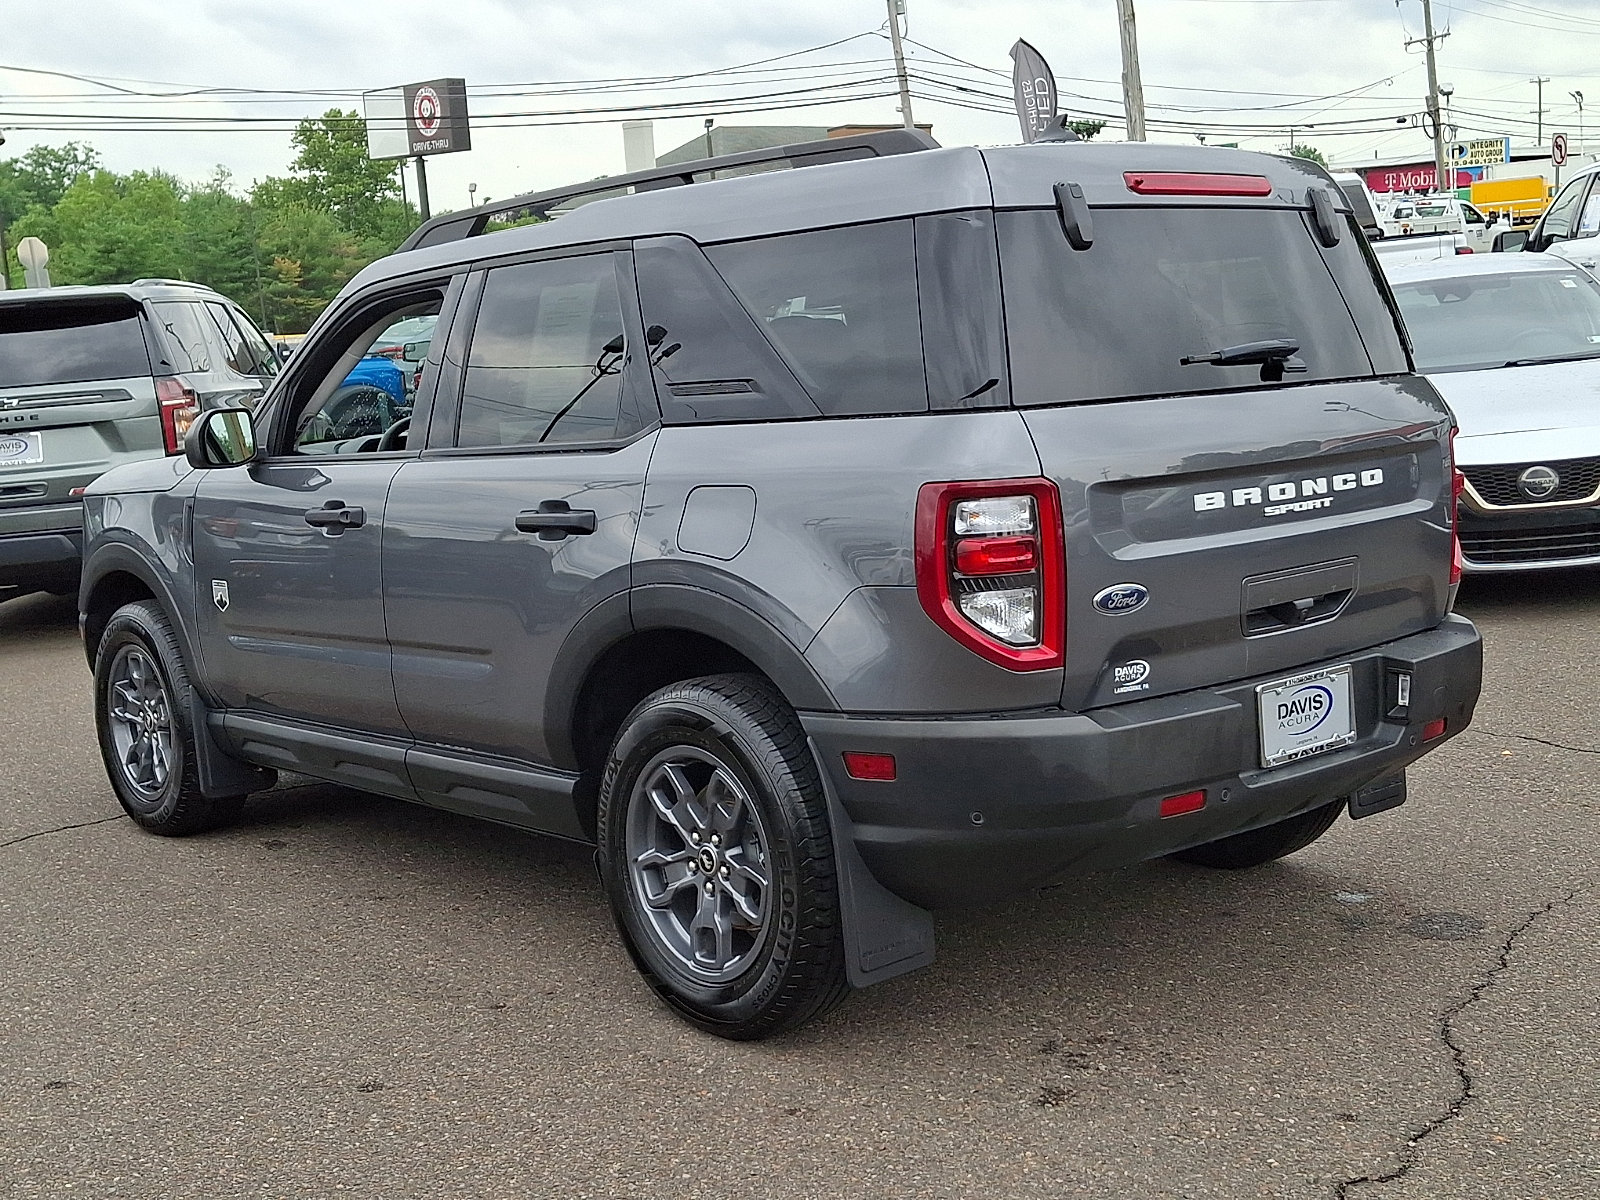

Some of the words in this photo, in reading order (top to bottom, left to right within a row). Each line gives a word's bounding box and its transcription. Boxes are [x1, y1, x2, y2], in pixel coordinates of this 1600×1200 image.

[413, 138, 449, 152] DRIVE-THRU
[1469, 139, 1504, 150] INTEGRITY
[1470, 150, 1485, 159] AUTO
[1485, 148, 1503, 158] GROUP
[1399, 169, 1438, 188] Mobil
[1193, 468, 1384, 512] BRONCO
[1263, 496, 1334, 517] SPORT
[1107, 589, 1139, 609] Ford
[1114, 665, 1144, 677] DAVIS
[1114, 673, 1142, 682] ACURA
[1278, 693, 1324, 721] DAVIS
[1278, 712, 1320, 730] ACURA
[1287, 741, 1336, 760] DAVIS
